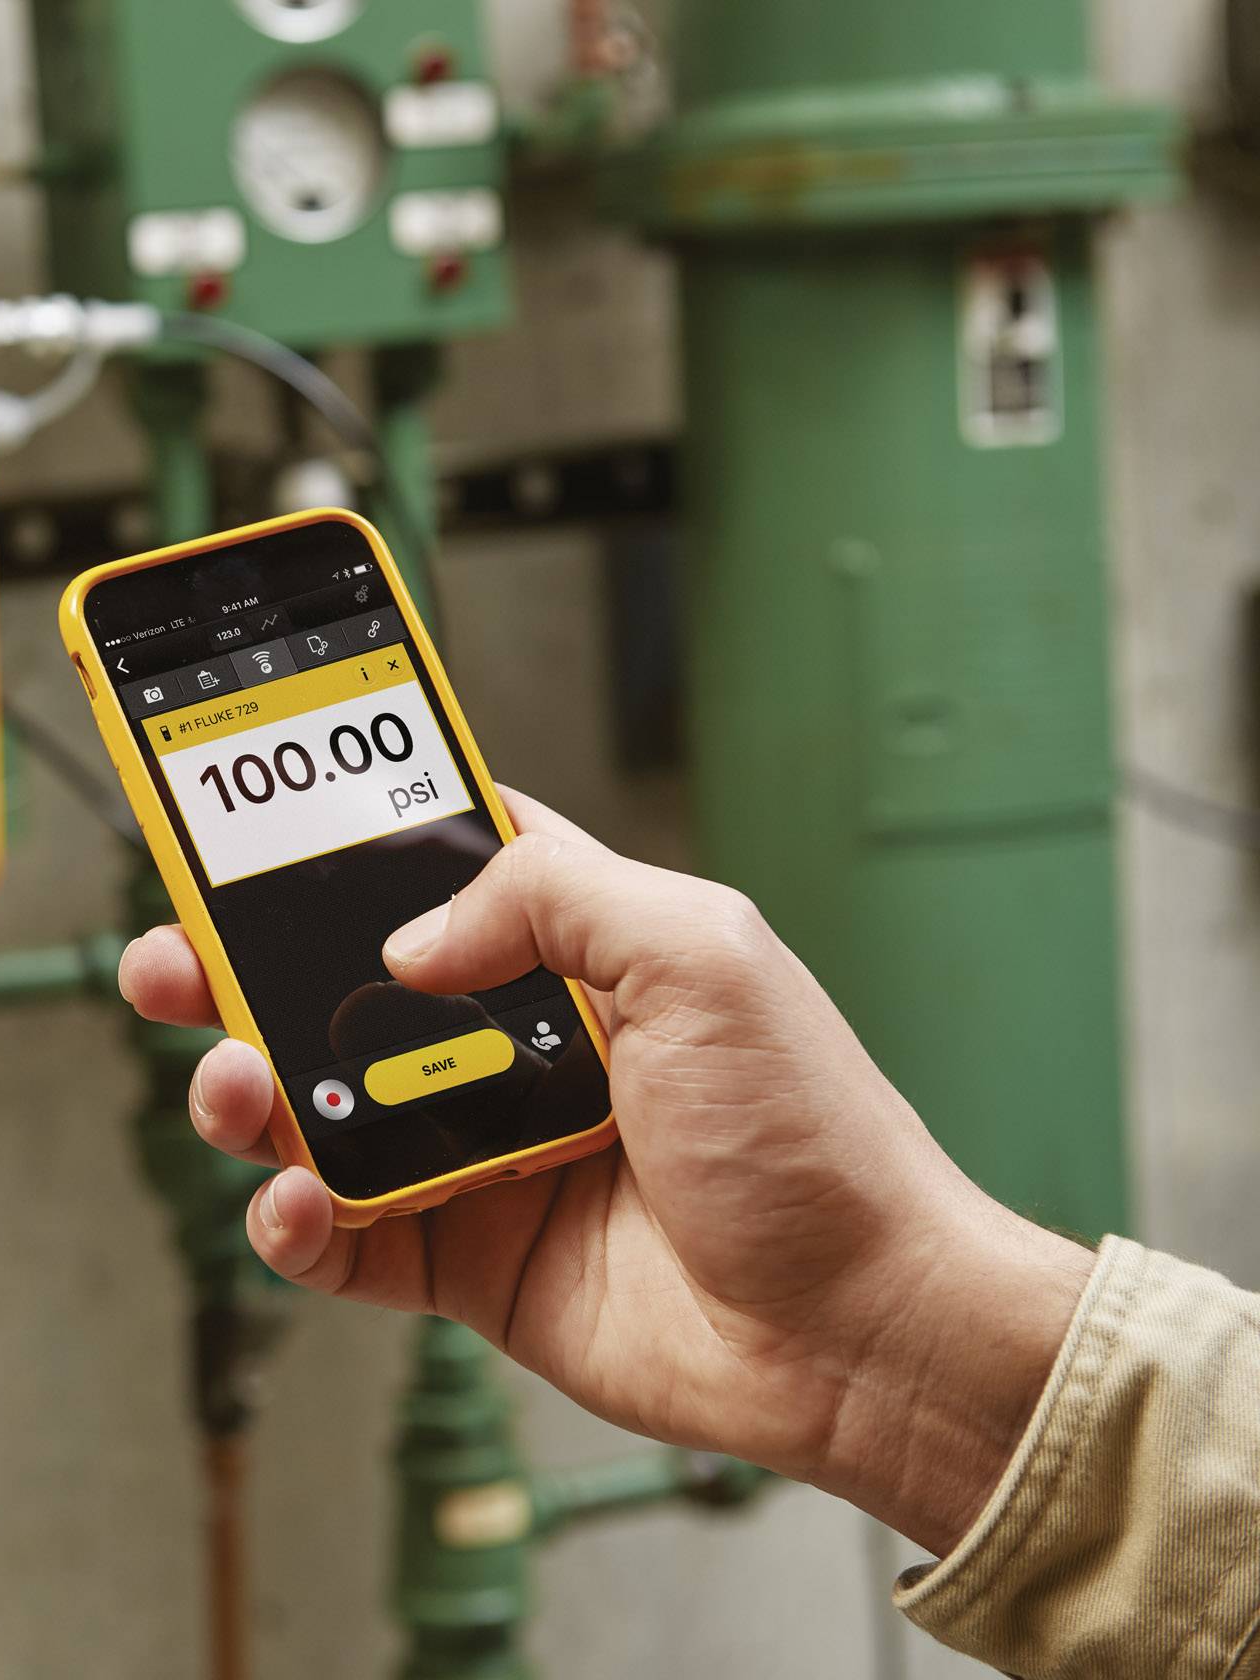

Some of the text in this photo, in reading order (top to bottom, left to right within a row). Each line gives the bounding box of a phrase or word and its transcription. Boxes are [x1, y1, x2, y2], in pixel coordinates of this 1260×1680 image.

[221, 596, 259, 614] 9:41 AM
[132, 618, 186, 641] Verizon LTE
[216, 627, 241, 641] 123.0
[179, 701, 259, 734] #1 FLUKE 729
[199, 712, 414, 813] 100.00
[387, 771, 439, 818] psi
[421, 1057, 458, 1077] SAVE
